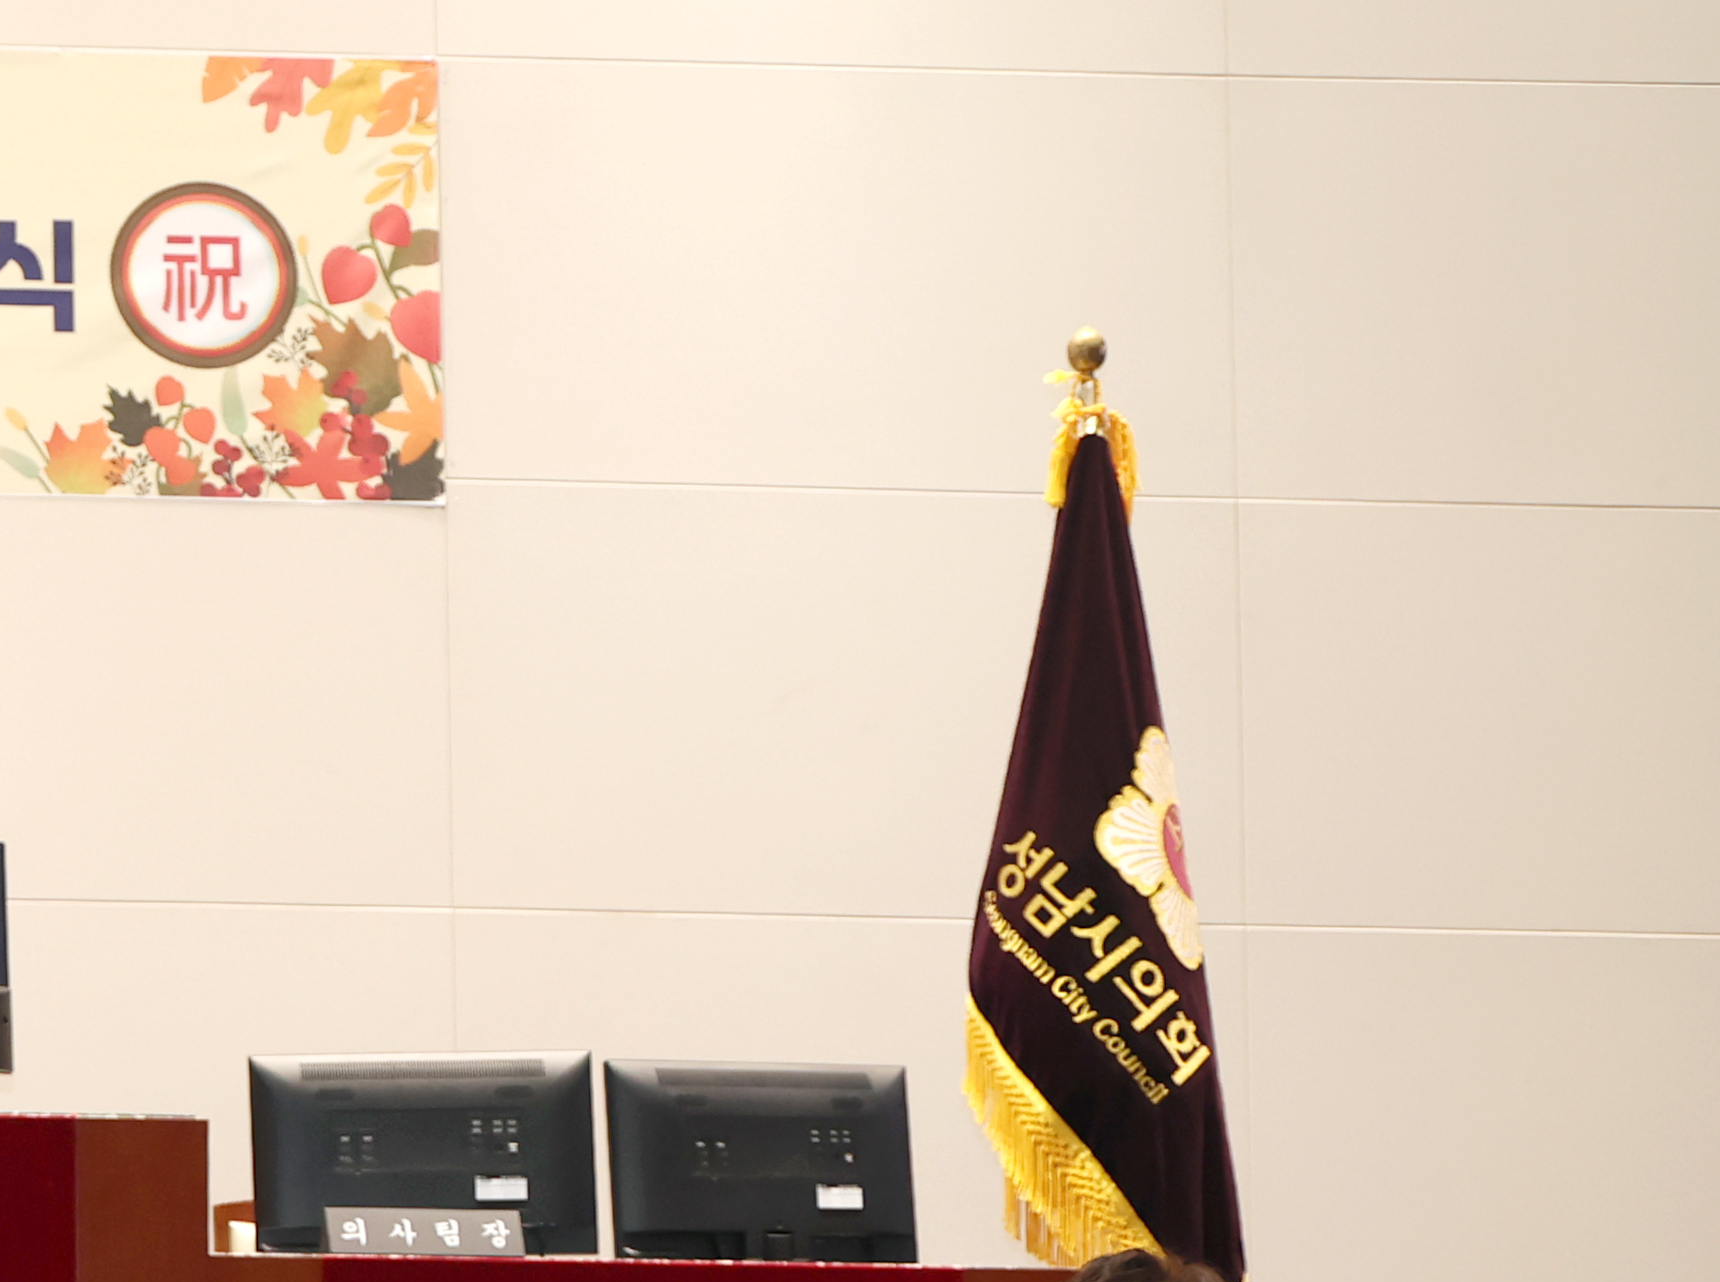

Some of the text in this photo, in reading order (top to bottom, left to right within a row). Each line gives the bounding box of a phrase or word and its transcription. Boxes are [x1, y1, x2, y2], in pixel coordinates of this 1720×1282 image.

[162, 235, 247, 322] 祝
[984, 889, 1169, 1104] Seongnam City Council
[997, 830, 1211, 1086] 성남시의회
